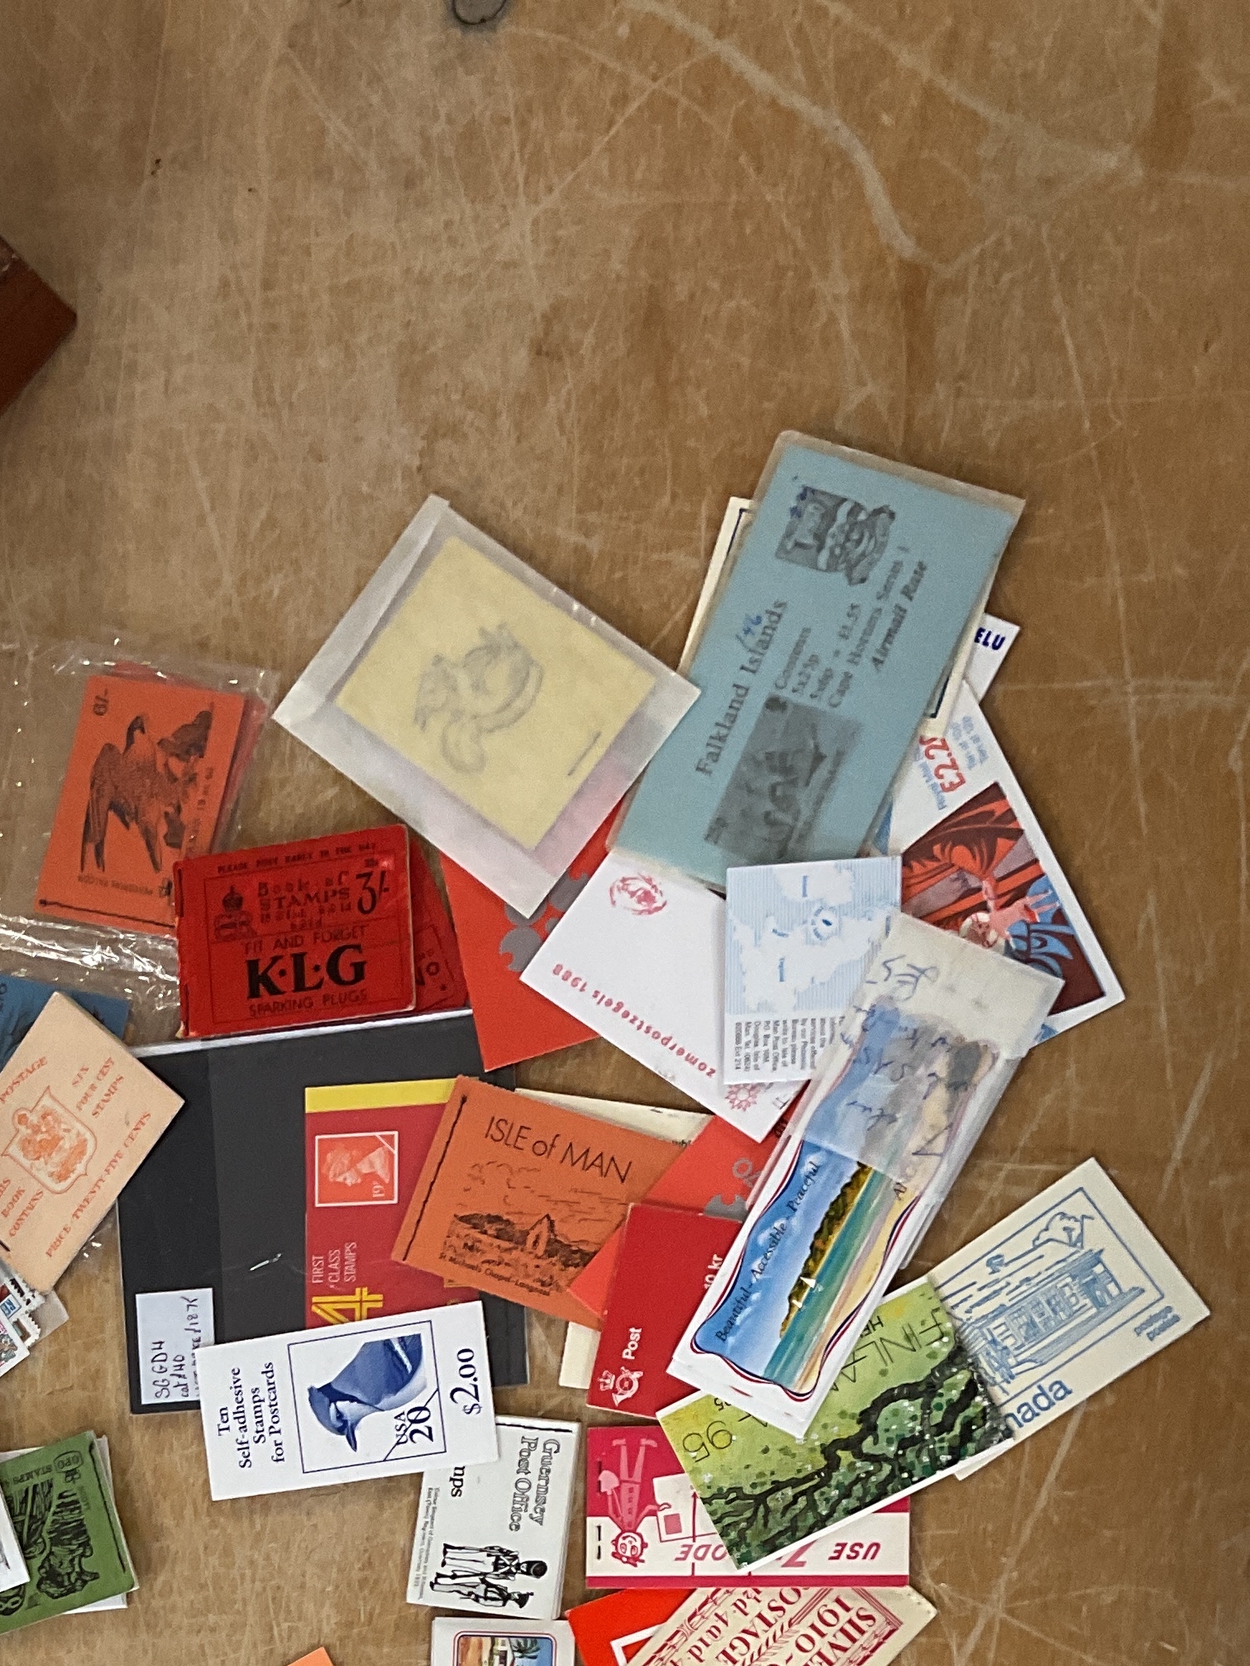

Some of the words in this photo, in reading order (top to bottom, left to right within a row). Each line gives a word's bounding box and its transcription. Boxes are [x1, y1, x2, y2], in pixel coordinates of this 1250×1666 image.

[872, 604, 908, 672] Airmail
[900, 559, 928, 602] Rate
[695, 684, 750, 777] Falkland
[748, 598, 788, 678] Islands
[260, 885, 351, 910] STAMPS
[273, 935, 304, 949] AND
[313, 923, 369, 944] FORGET
[552, 963, 588, 993] 1988
[250, 999, 314, 1019] SPARKING
[322, 989, 368, 1007] PLUGS
[592, 989, 716, 1078] zomerpostzegels
[71, 1065, 90, 1087] SIX
[75, 1083, 98, 1112] FOUR
[91, 1075, 124, 1119] STAMPS
[485, 1116, 531, 1150] ISLE
[532, 1133, 560, 1157] of
[560, 1142, 632, 1184] MAN
[0, 1186, 26, 1218] BOOK
[45, 1225, 72, 1258] PRICE
[123, 1111, 152, 1148] CENTS
[8, 1190, 44, 1237] CONTAINS
[312, 1255, 325, 1284] FIRST
[329, 1249, 341, 1284] CLASS
[344, 1242, 358, 1282] STAMPS
[707, 1254, 723, 1270] kr
[715, 1288, 751, 1342] Beautiful
[750, 1222, 787, 1281] Accessible
[787, 1162, 820, 1213] Peaceful
[623, 1327, 642, 1360] Post
[173, 1381, 188, 1398] cat
[450, 1348, 482, 1415] $2.00
[217, 1406, 230, 1437] Ten
[230, 1367, 252, 1470] Self-adhesive
[253, 1386, 267, 1444] Stamps
[261, 1361, 281, 1444] Postcards
[393, 1411, 407, 1445] USA
[405, 1404, 434, 1444] 20
[270, 1444, 285, 1463] for
[518, 1435, 539, 1474] Post
[530, 1438, 561, 1527] Guernsey
[509, 1477, 532, 1532] Office
[828, 1541, 882, 1562] USE
[794, 1596, 852, 1651] 1910
